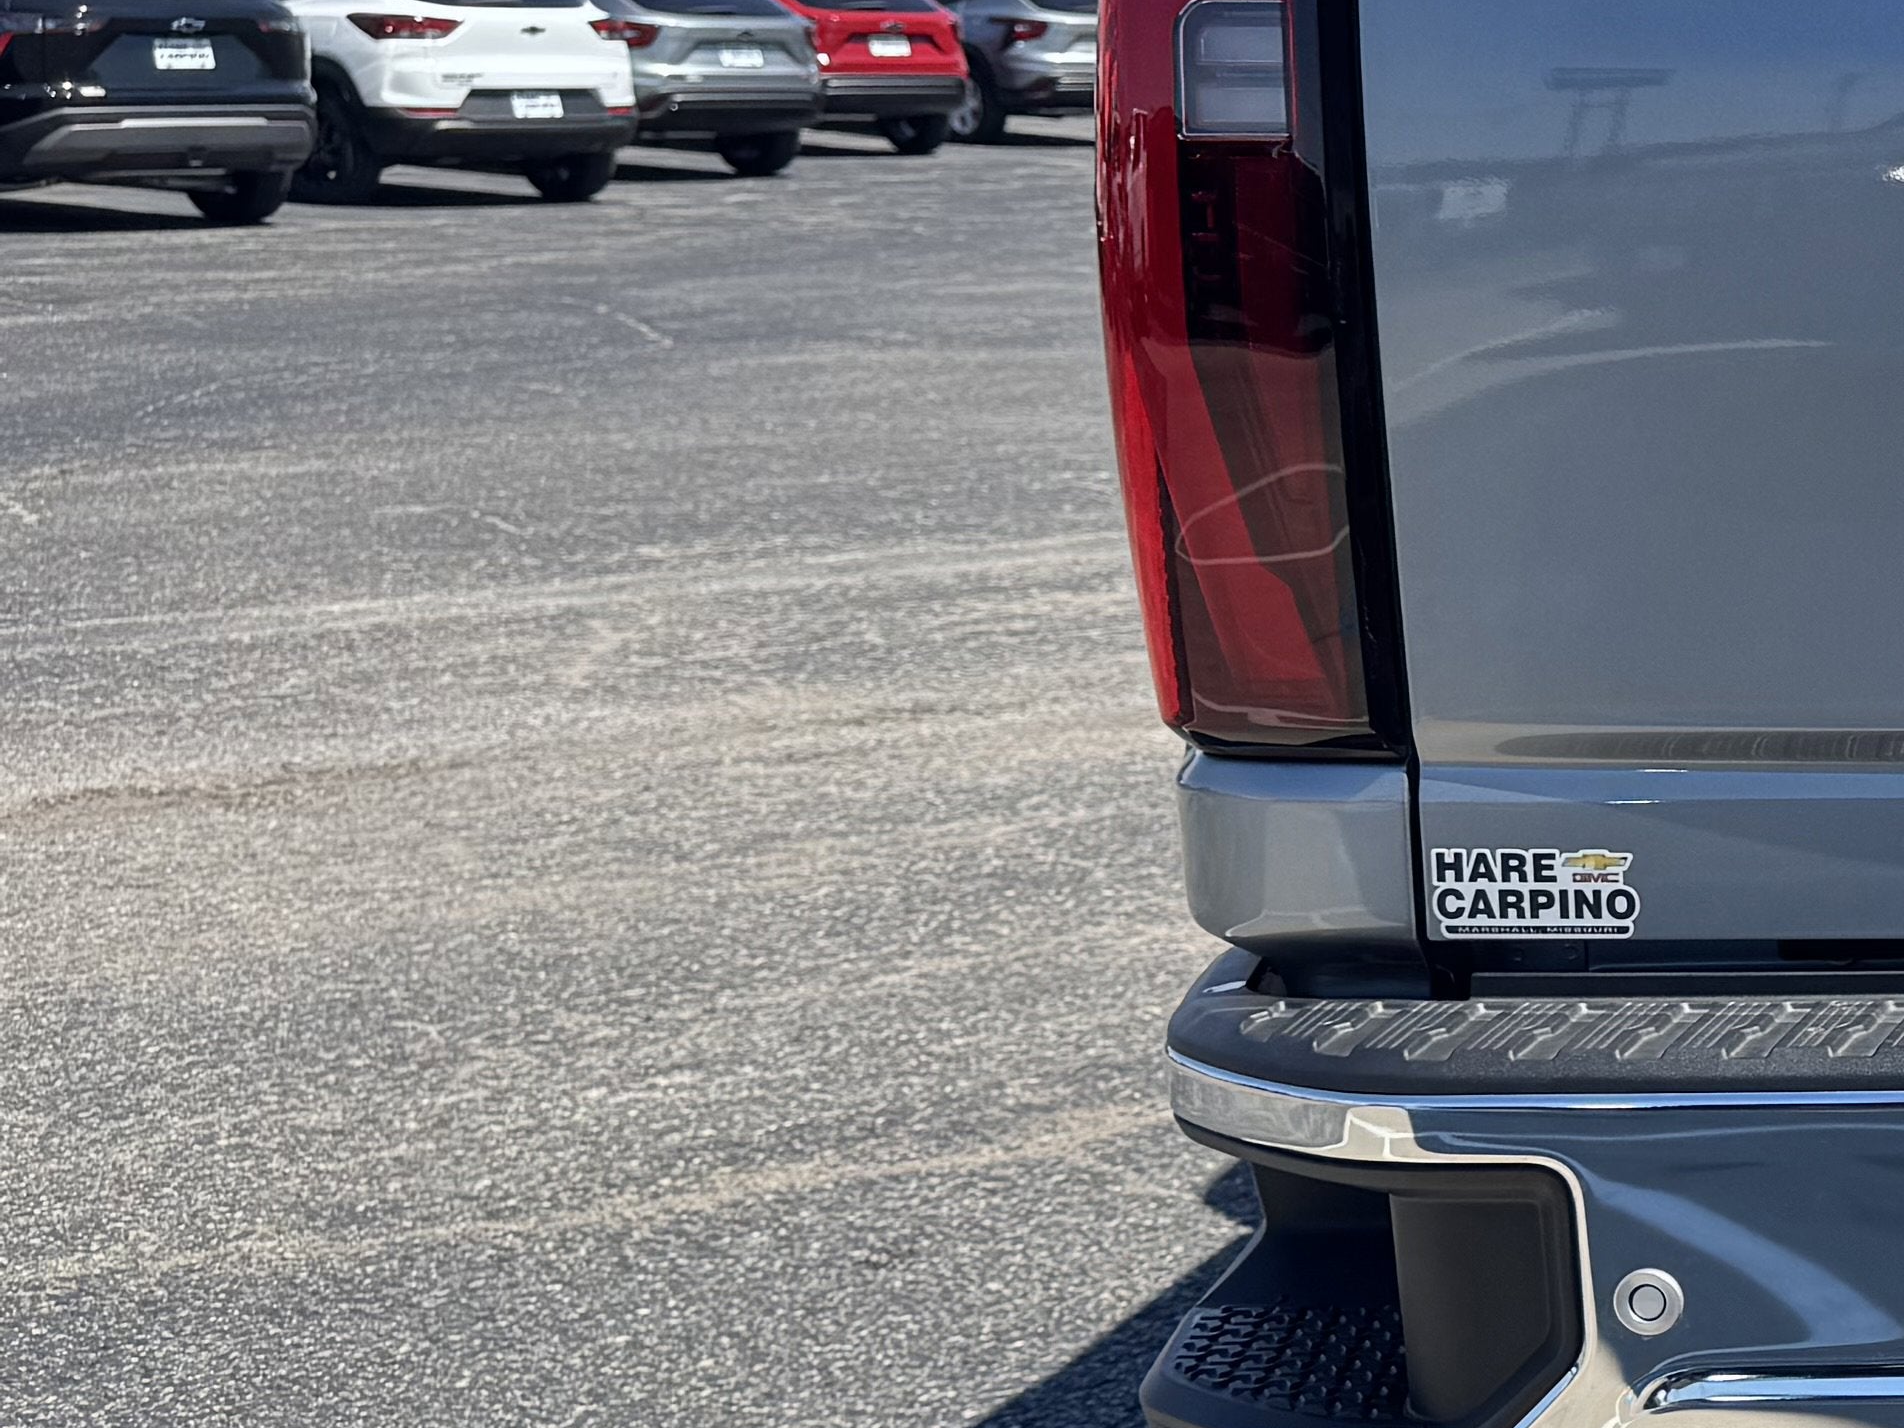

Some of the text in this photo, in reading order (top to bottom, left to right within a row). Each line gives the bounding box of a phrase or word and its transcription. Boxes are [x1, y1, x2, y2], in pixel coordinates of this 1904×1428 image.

[1436, 852, 1558, 883] HARE
[1573, 872, 1620, 883] GMC
[1437, 888, 1637, 919] CARPINO
[1546, 926, 1619, 934] MISSOURI
